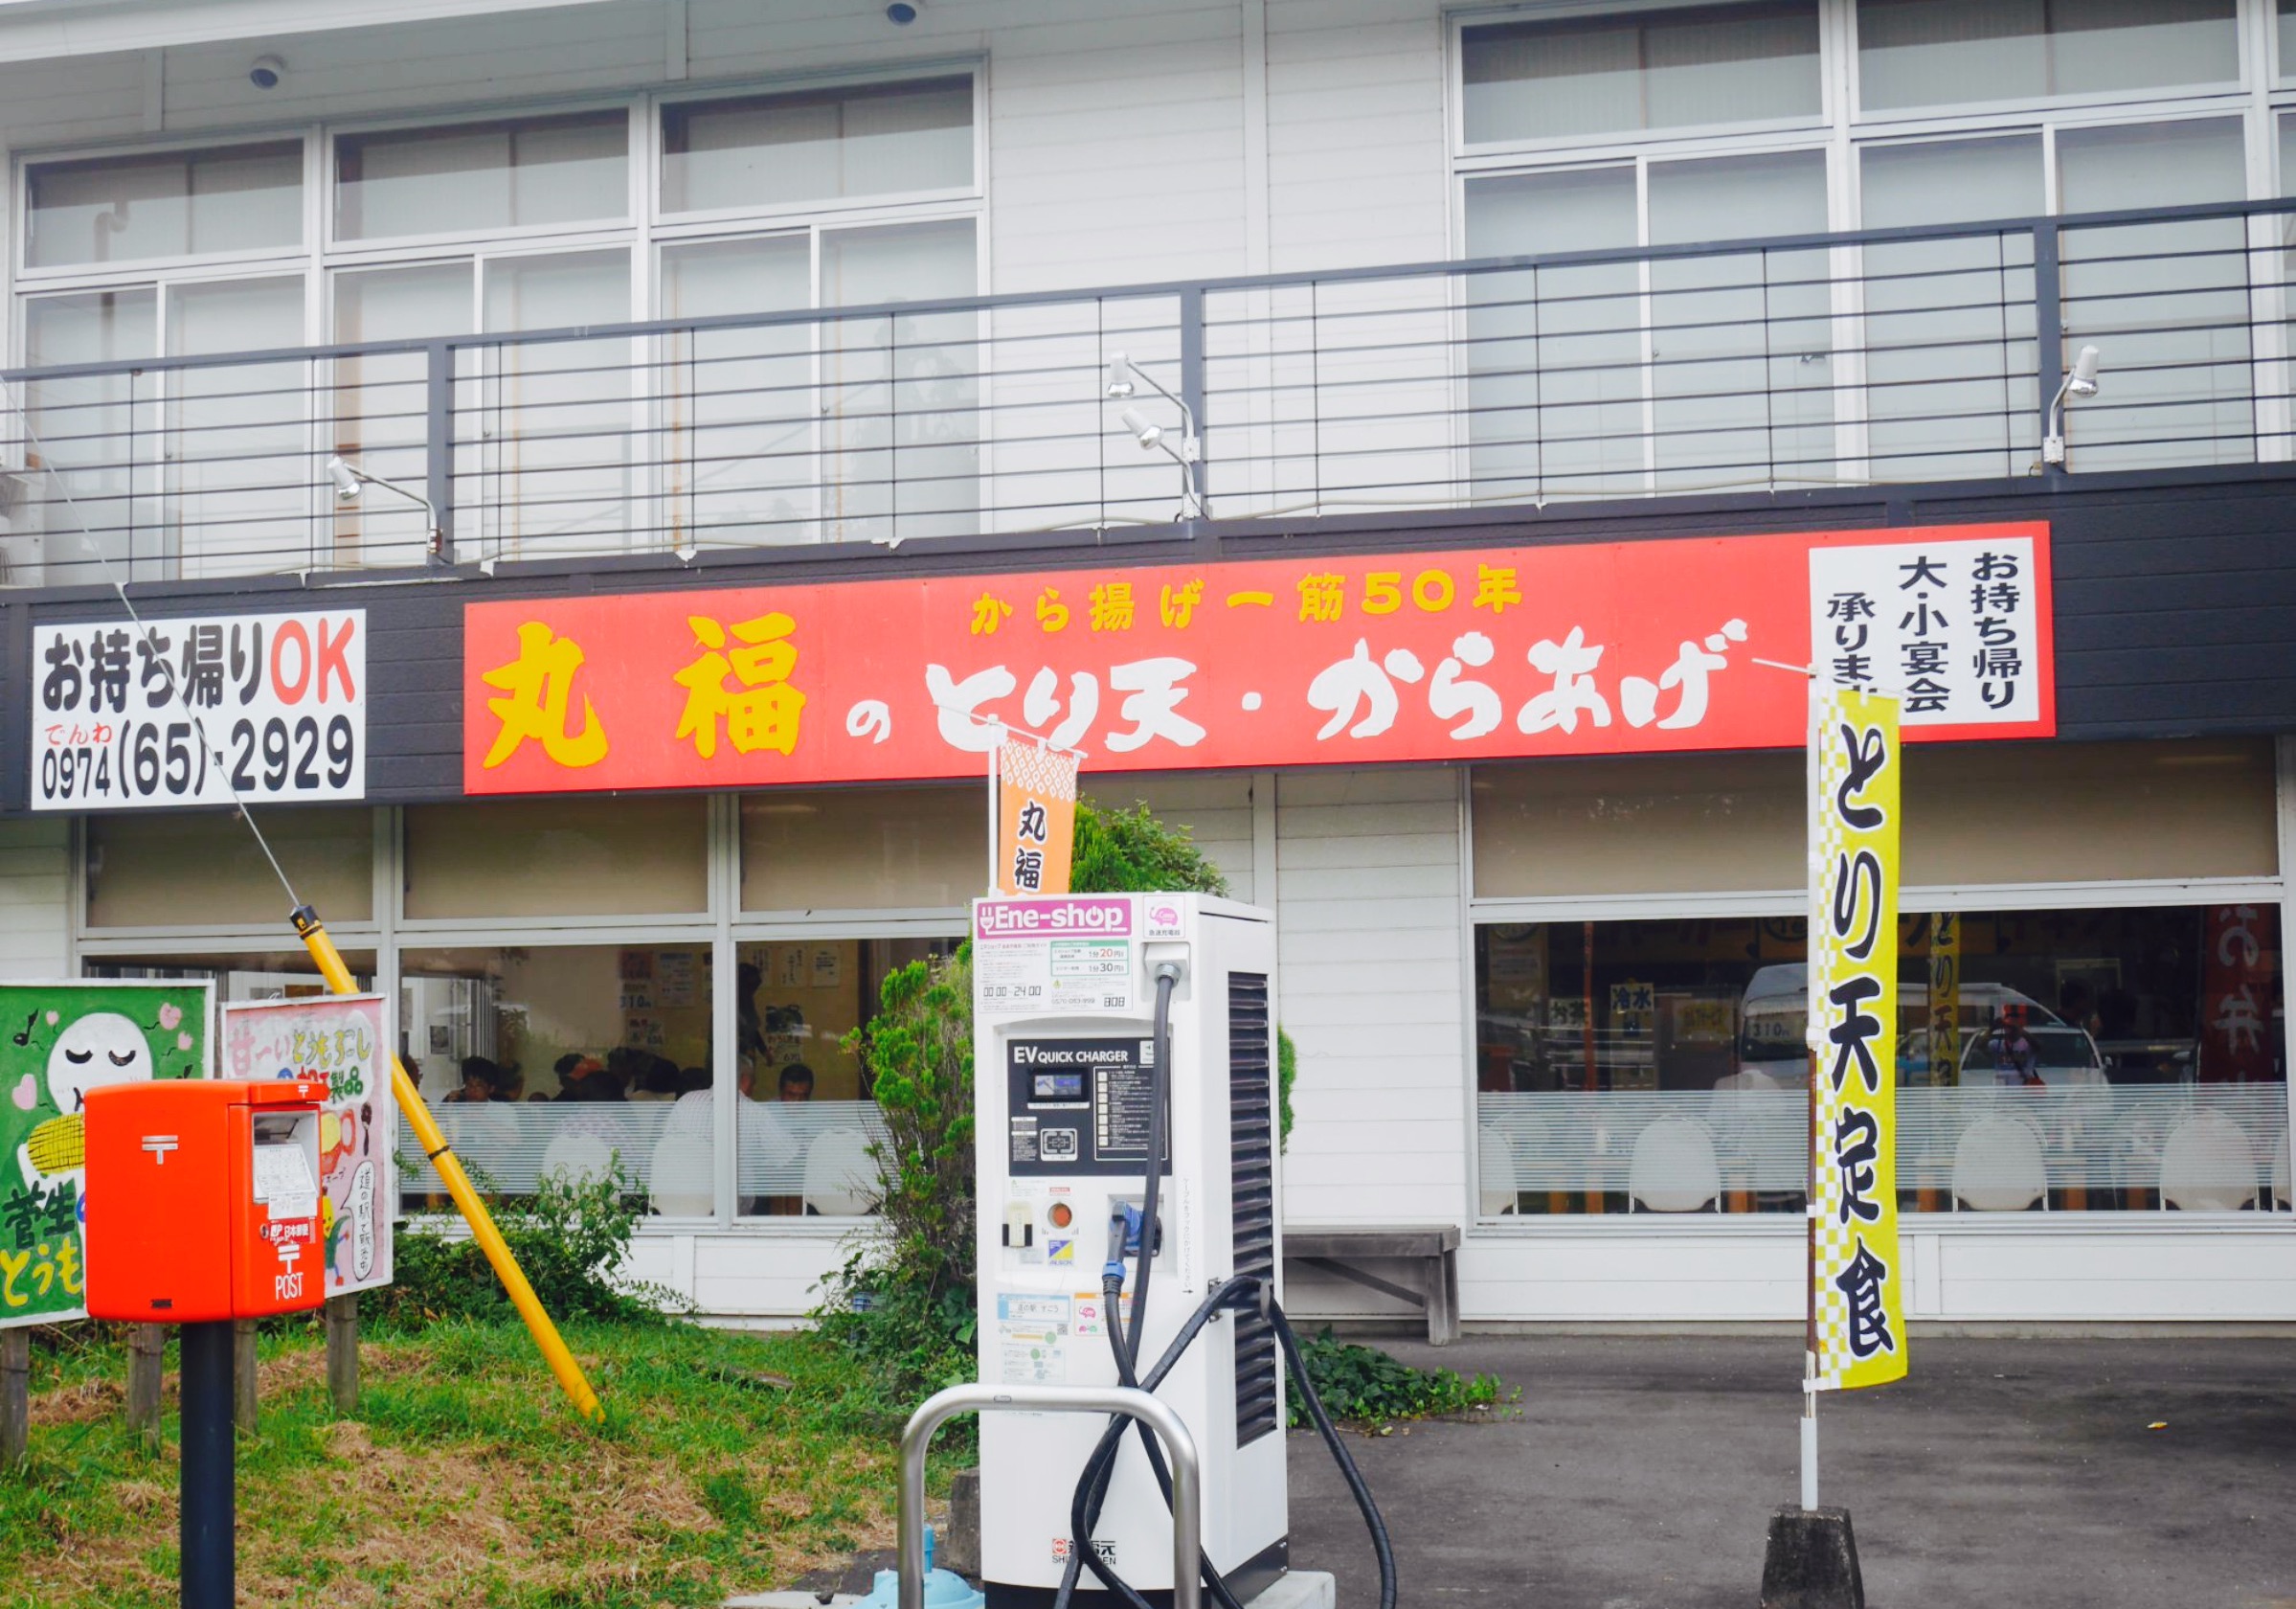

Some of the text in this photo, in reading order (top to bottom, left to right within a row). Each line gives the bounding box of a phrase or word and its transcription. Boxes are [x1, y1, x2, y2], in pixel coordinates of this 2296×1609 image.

[970, 563, 1524, 635] から揚げ一筋50年
[1826, 591, 1878, 692] 承りま
[1970, 551, 2022, 710] お持ち帰り
[45, 722, 113, 745] でんわ
[1014, 800, 1047, 890] 丸福
[996, 903, 1123, 932] Ene-shop
[1611, 986, 1652, 1009] 冷水
[1013, 1046, 1129, 1064] EV QUICK CHARGER
[1828, 720, 1893, 1359] とり天定食
[275, 1271, 304, 1302] POST
